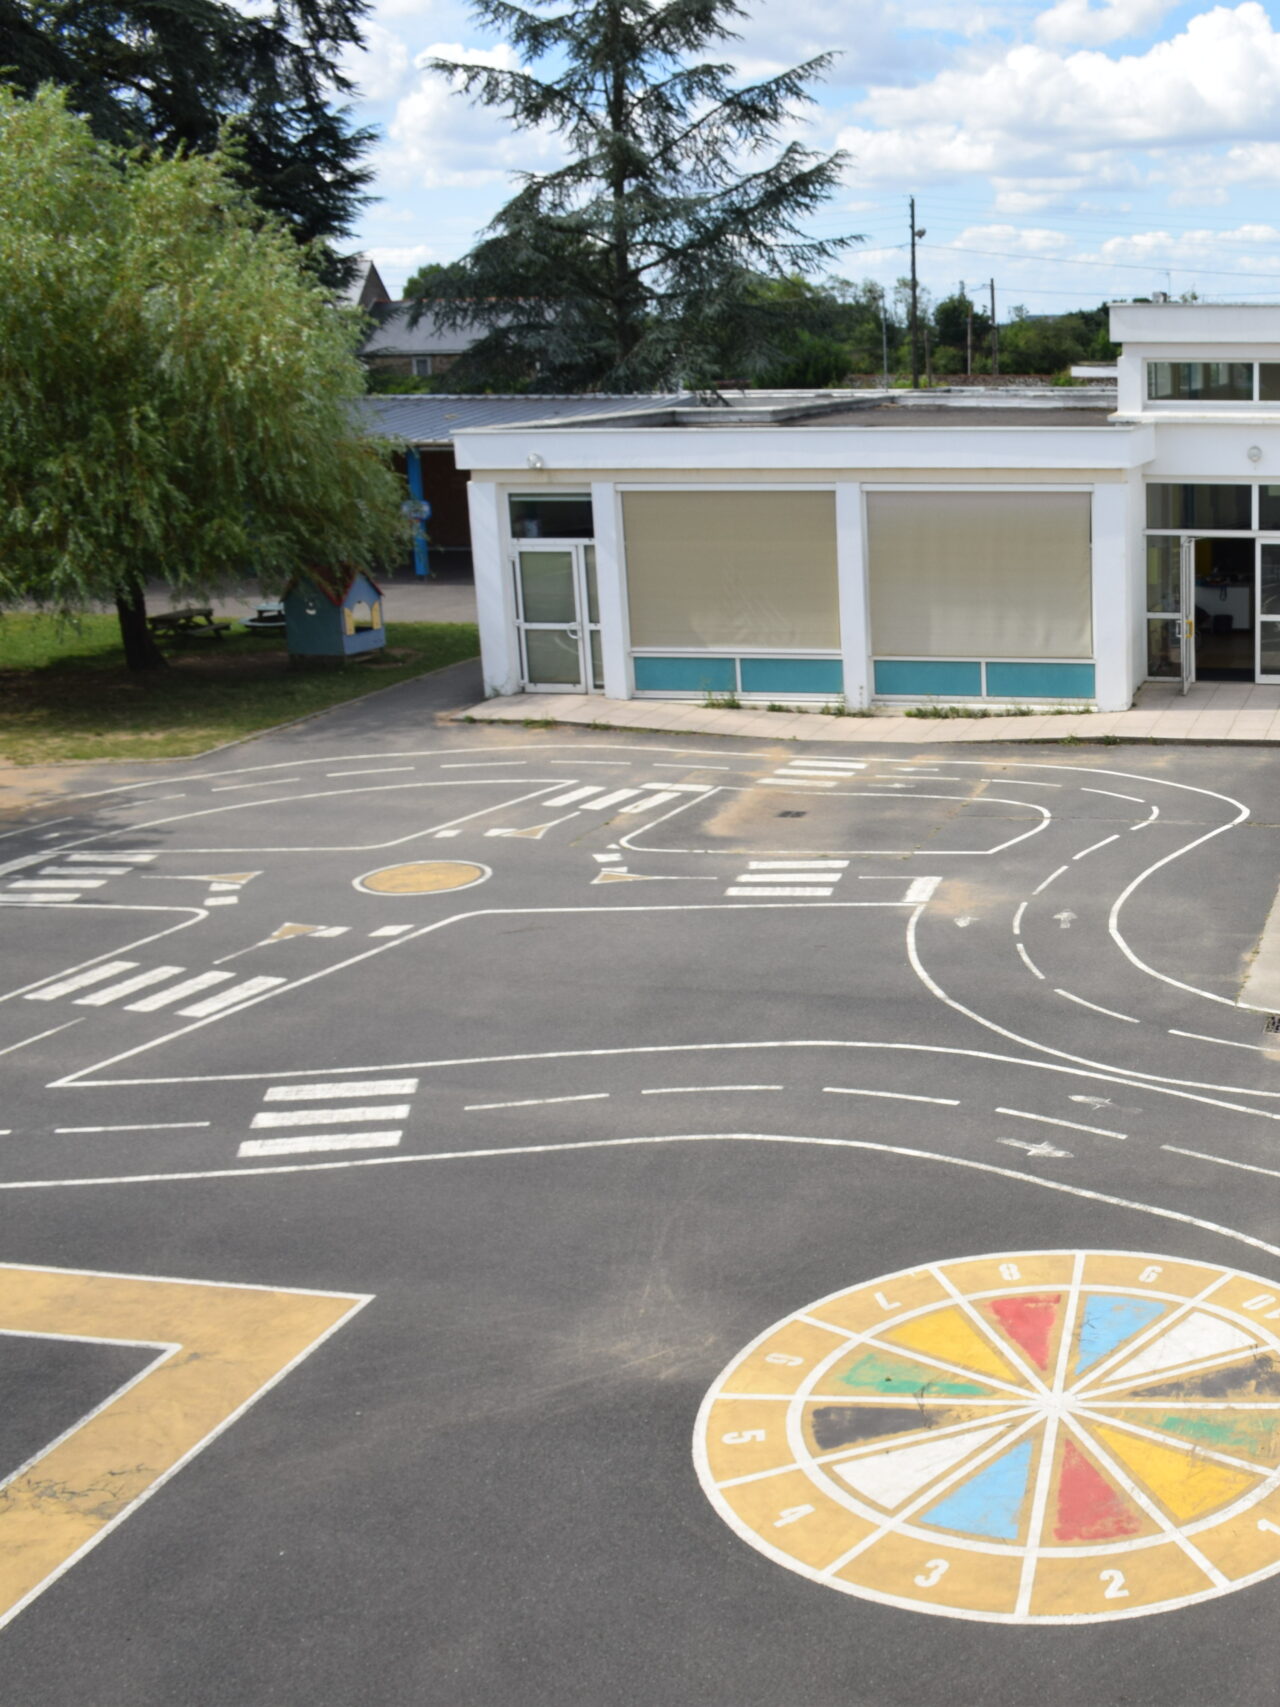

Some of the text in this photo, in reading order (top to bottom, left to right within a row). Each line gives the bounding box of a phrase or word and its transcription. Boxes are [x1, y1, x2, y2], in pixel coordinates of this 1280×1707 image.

[997, 1263, 1021, 1281] 8
[1138, 1265, 1163, 1283] 9
[873, 1291, 903, 1311] 7
[763, 1352, 805, 1367] 6
[721, 1428, 767, 1445] 5
[772, 1504, 815, 1528] 4
[914, 1558, 950, 1587] 3
[1099, 1569, 1130, 1599] 2
